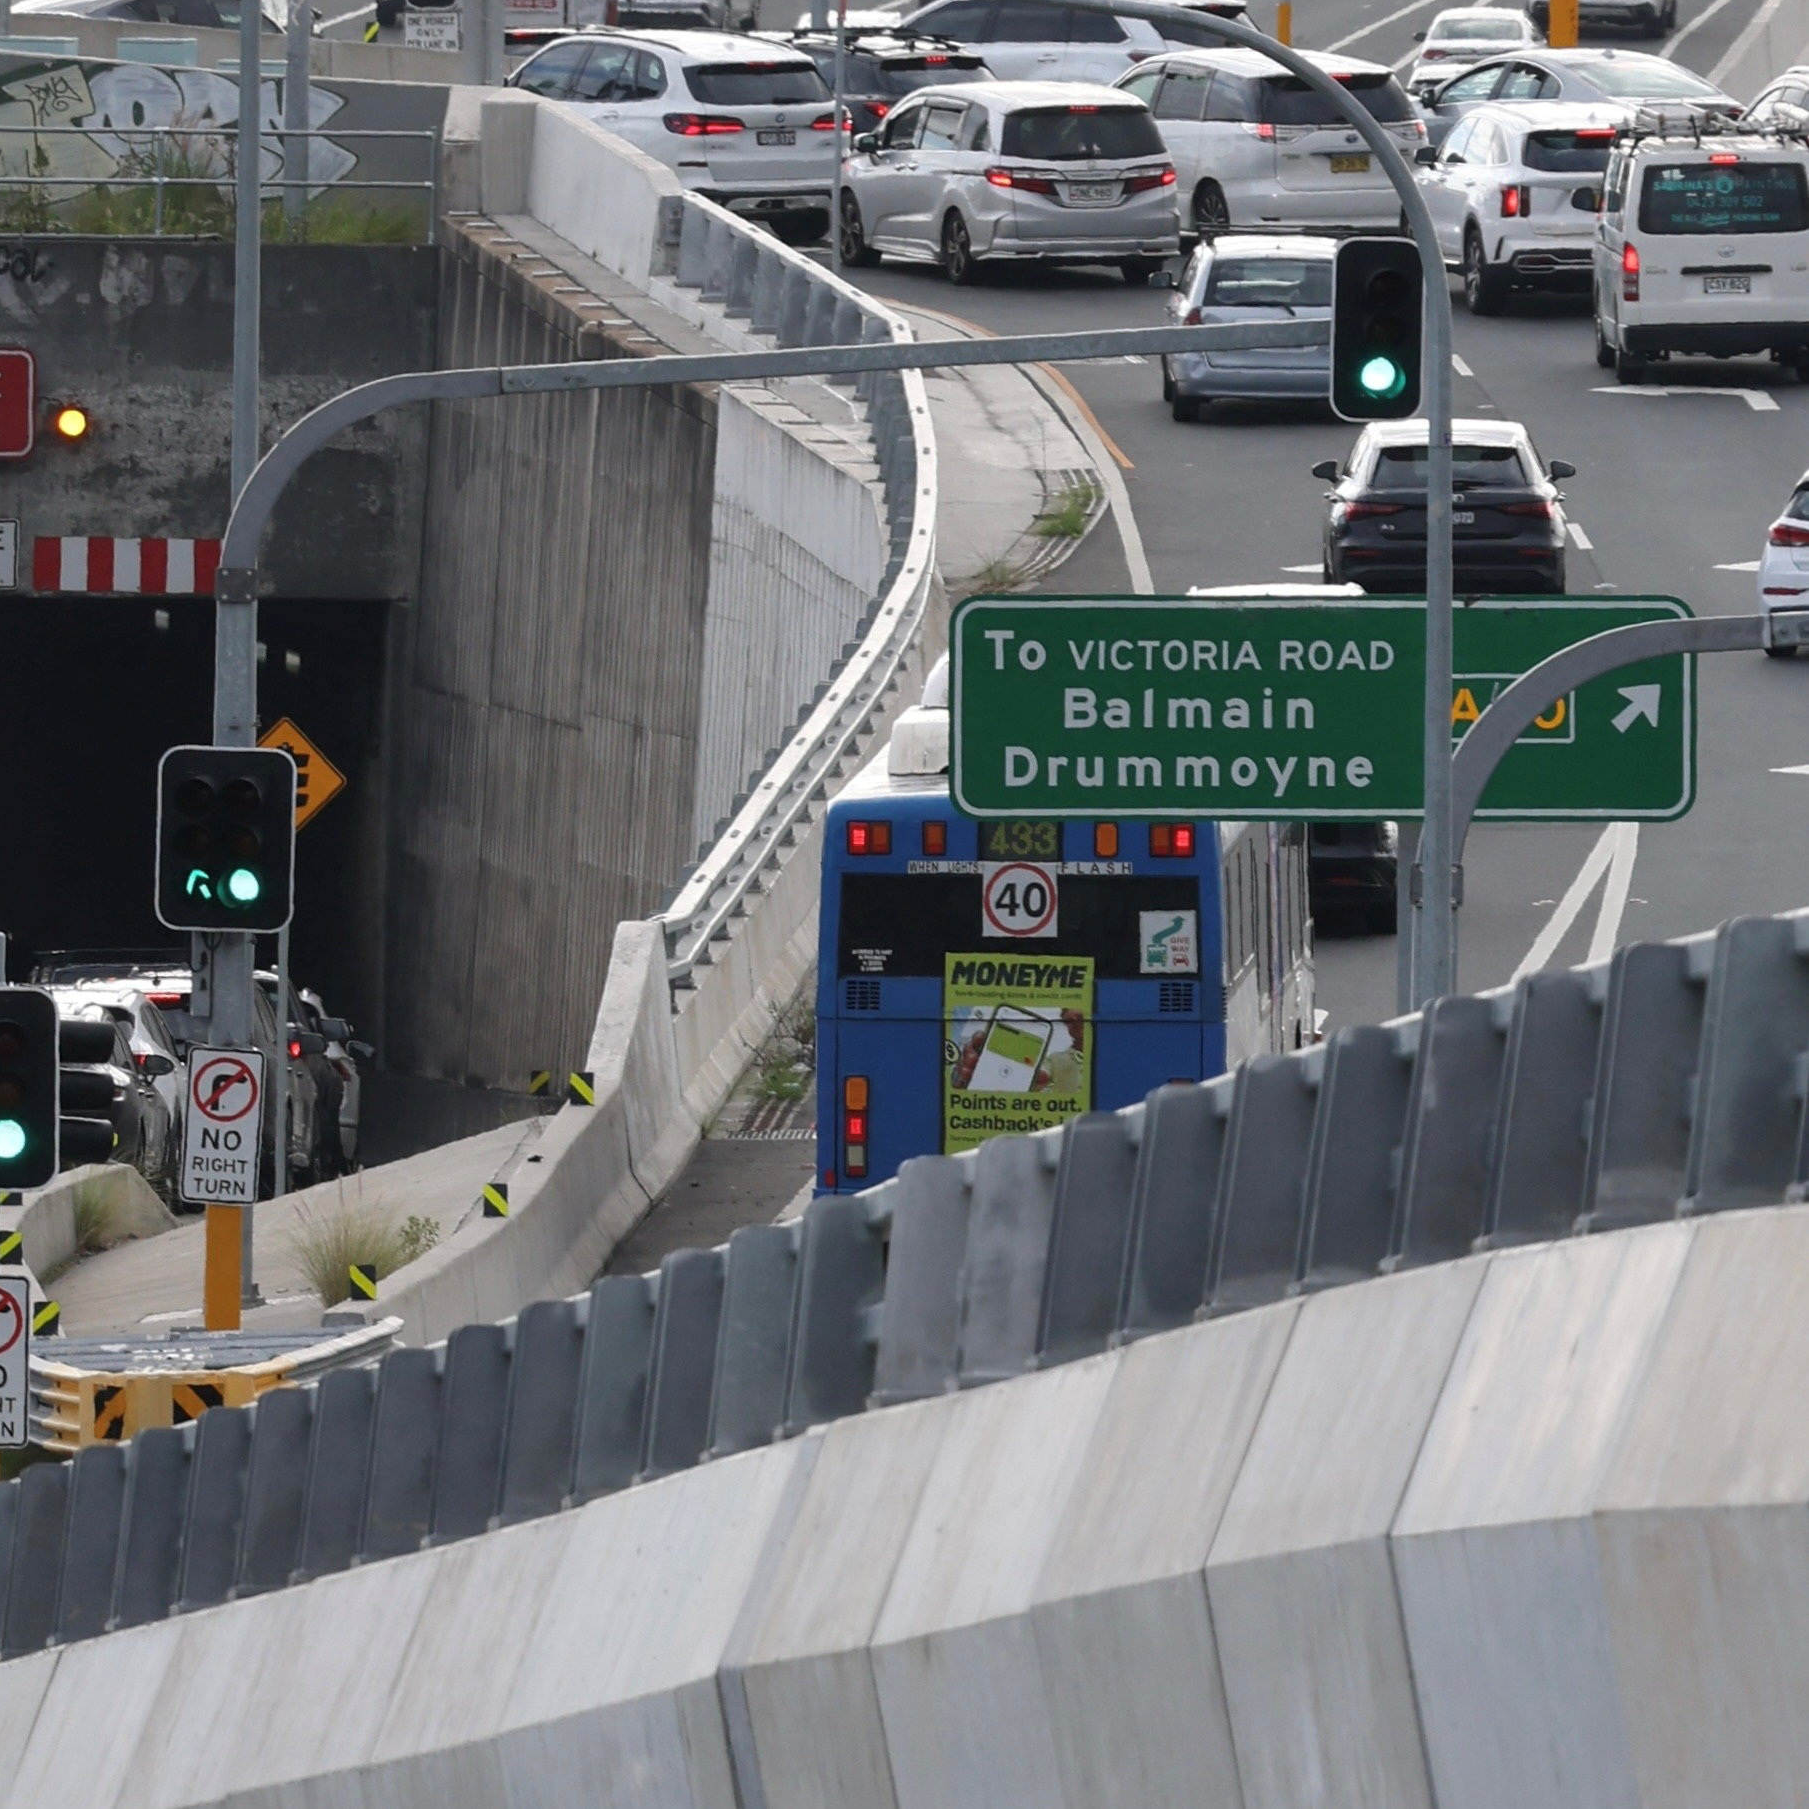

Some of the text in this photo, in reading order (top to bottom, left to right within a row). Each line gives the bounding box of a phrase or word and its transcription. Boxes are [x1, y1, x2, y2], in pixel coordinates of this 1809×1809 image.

[417, 28, 444, 38] ONLY
[984, 630, 1395, 672] To VICTORIA ROAD
[1064, 688, 1315, 731] Balmain
[1004, 745, 1374, 798] Drummoyne
[989, 822, 1058, 855] 433
[909, 862, 980, 873] WHEN LIGHTS
[1060, 863, 1132, 874] FLASH
[994, 882, 1048, 918] 40
[951, 961, 1087, 989] MONEYME
[949, 1093, 1082, 1113] Points are out.
[949, 1115, 1053, 1135] Cashback's
[201, 1129, 242, 1152] NO
[192, 1156, 249, 1176] RIGHT
[194, 1177, 246, 1195] TURN
